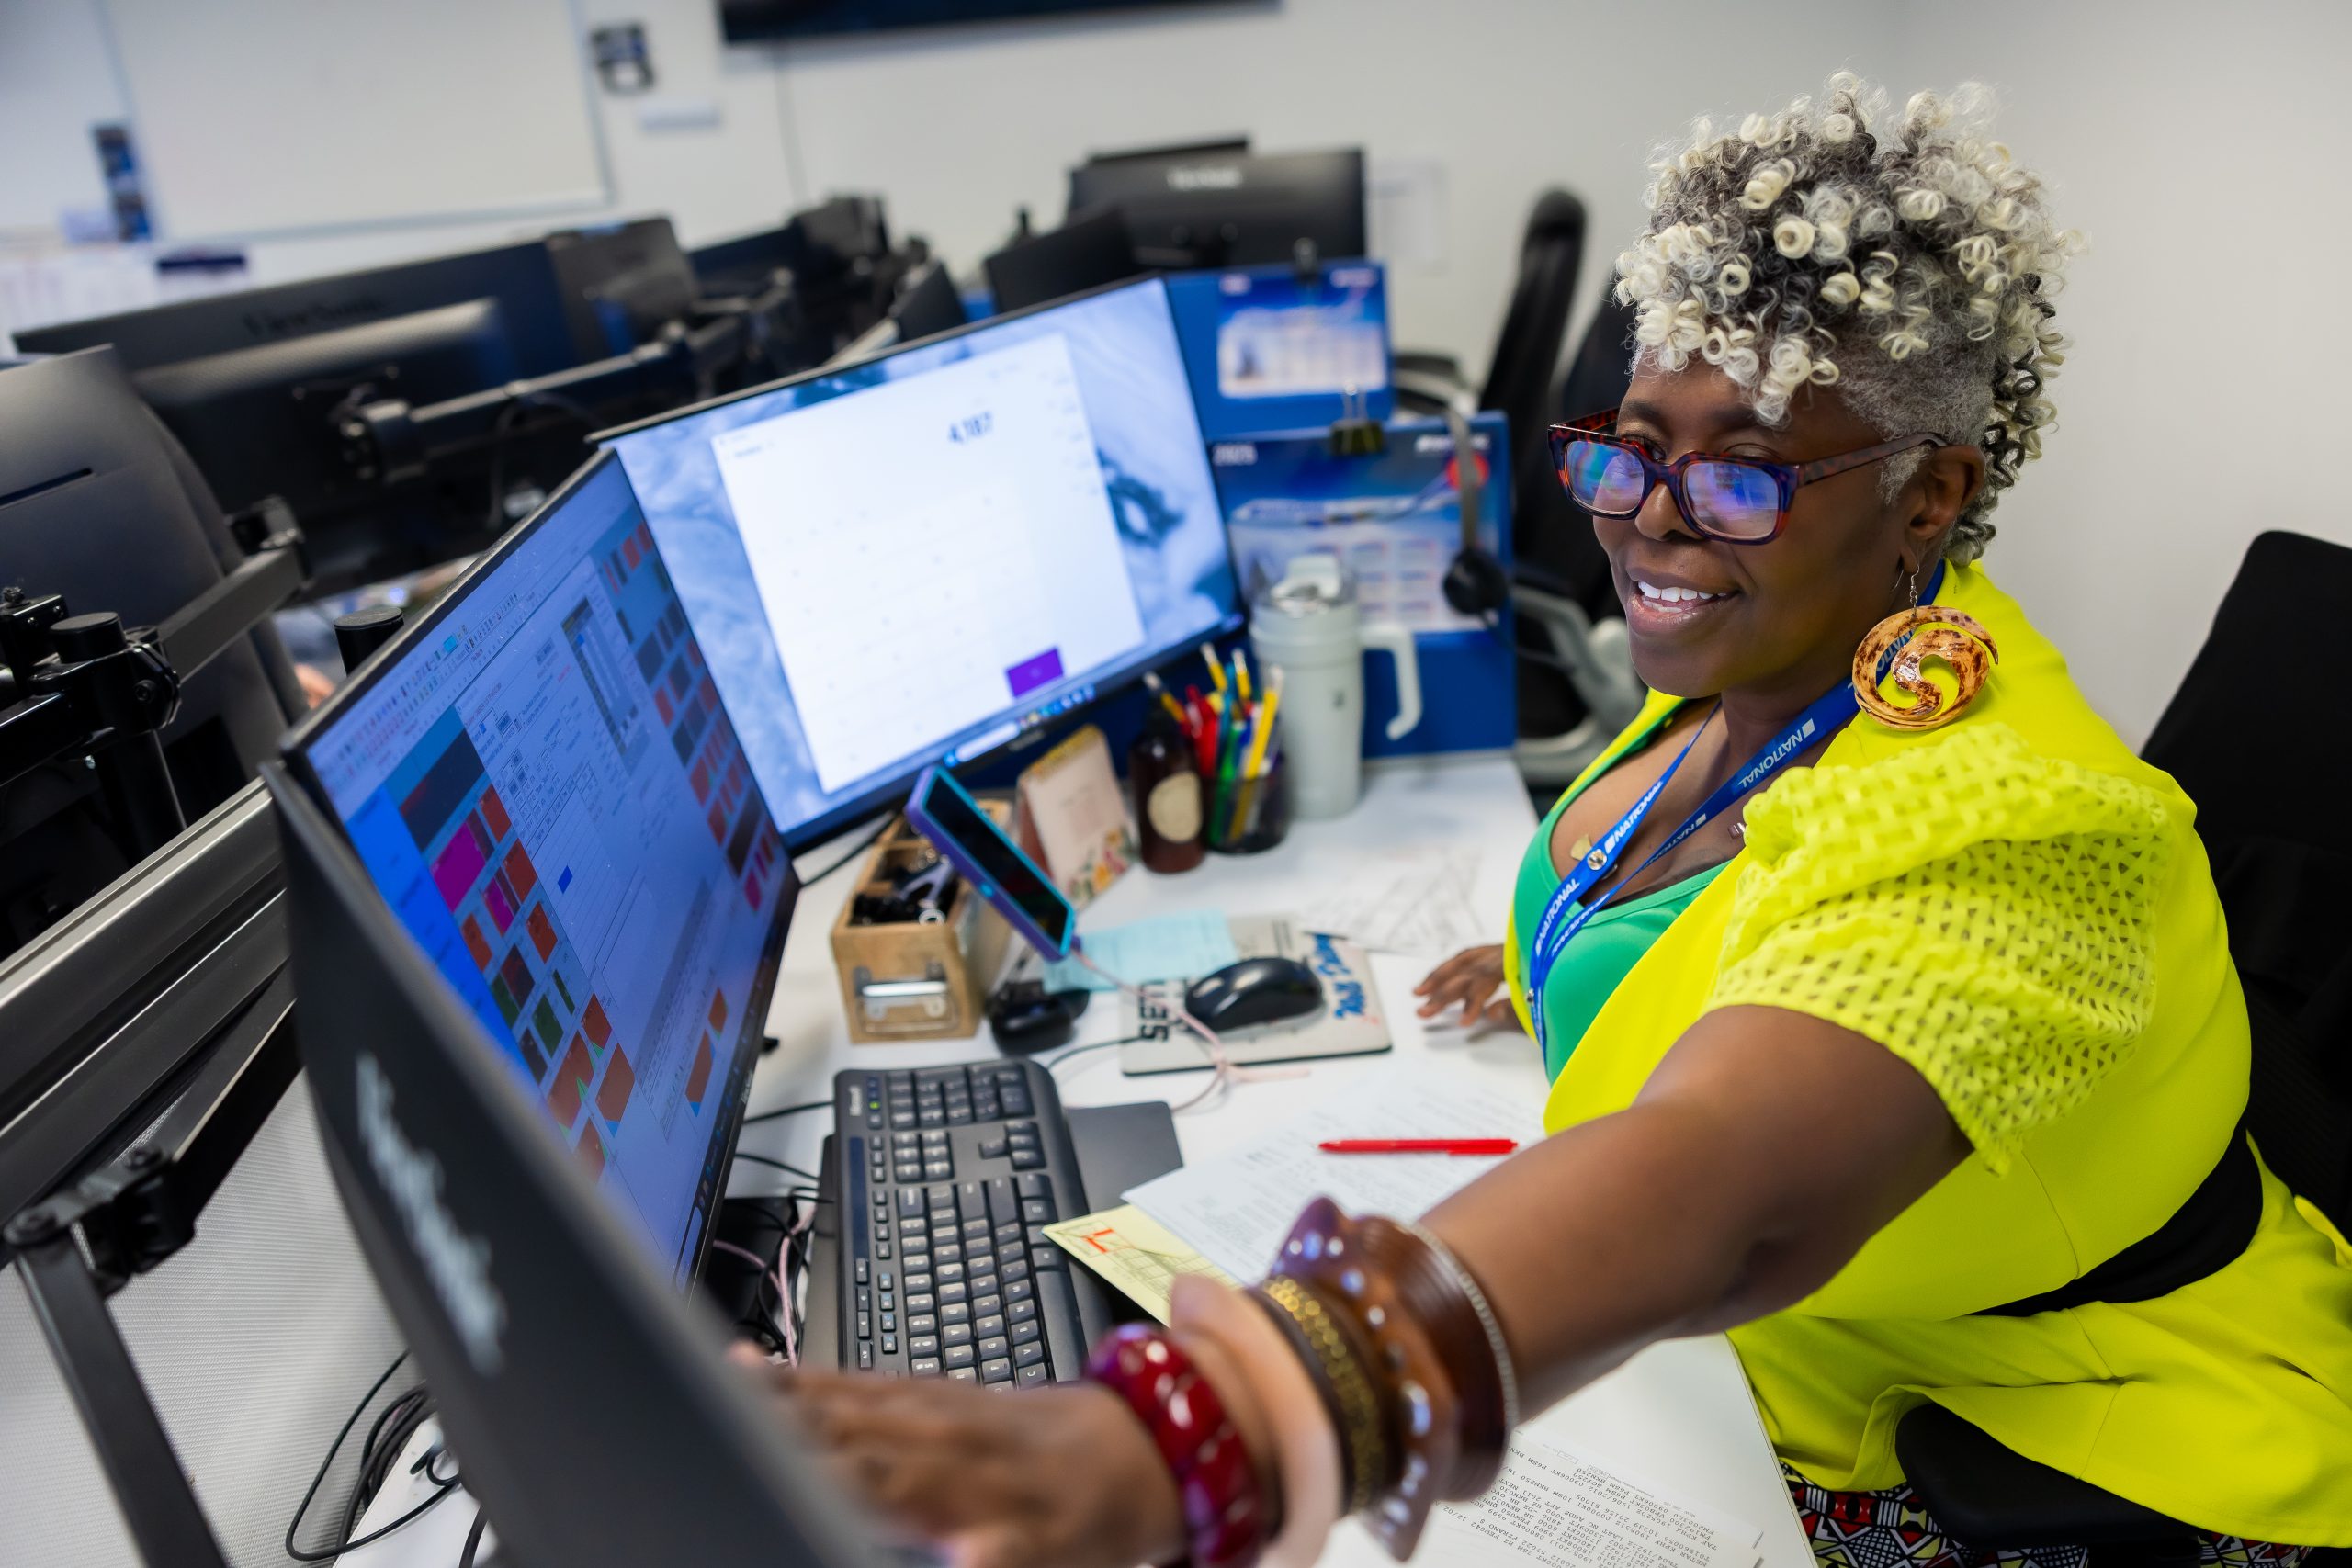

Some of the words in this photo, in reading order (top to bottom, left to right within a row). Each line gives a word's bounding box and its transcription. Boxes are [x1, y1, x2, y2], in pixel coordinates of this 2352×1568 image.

[1738, 729, 1804, 788] NATIONAL
[1614, 781, 1664, 842] NATIONAL
[1539, 877, 1580, 943] NATIONAL
[1528, 1457, 1547, 1470] P6SM
[1521, 1476, 1549, 1491] BKN250
[1551, 1470, 1584, 1486] 09006KT
[1573, 1472, 1602, 1488] SCT250
[1577, 1468, 1607, 1483] BKN250
[1499, 1479, 1519, 1490] NEXT
[1610, 1483, 1629, 1495] P6SM
[1500, 1486, 1528, 1502] BKN030
[1510, 1497, 1520, 1506] BR
[1523, 1490, 1541, 1501] 2011
[1553, 1490, 1572, 1503] 10SM
[1576, 1495, 1600, 1508] 51009
[1589, 1486, 1632, 1509] 1906/2012
[1606, 1488, 1626, 1499] P6SM
[1492, 1496, 1520, 1512] BKN030
[1545, 1501, 1561, 1510] AFT
[1577, 1502, 1611, 1521] 00000KT
[1630, 1499, 1664, 1518] VRB03KT
[1634, 1495, 1668, 1513] 09006KT
[1488, 1509, 1507, 1520] 9999
[1501, 1508, 1531, 1525] FEW050
[1543, 1513, 1561, 1526] 4800
[1546, 1509, 1566, 1520] 9000
[1565, 1511, 1585, 1522] AMDS
[1604, 1508, 1629, 1522] 20156
[1636, 1509, 1670, 1528] 190520Z
[1471, 1522, 1499, 1539] FEW042
[1510, 1520, 1544, 1540] 08006KT
[1534, 1526, 1554, 1537] 9999
[1538, 1519, 1557, 1531] 6000
[1569, 1520, 1604, 1540] 33009KT
[1615, 1521, 1649, 1540] 190551Z
[1634, 1522, 1659, 1537] 10239
[1669, 1516, 1711, 1540] FM192300
[1674, 1514, 1714, 1535] FM200300
[1562, 1531, 1596, 1551] 18006KT
[1566, 1527, 1600, 1545] 17006KT
[1601, 1529, 1623, 1541] LAST
[1676, 1528, 1697, 1540] KPHX
[1521, 1540, 1546, 1555] 57022
[1557, 1537, 1592, 1556] 15008KT
[1609, 1540, 1654, 1563] 2001/2002
[1655, 1540, 1676, 1552] KPHX
[1662, 1537, 1710, 1562] T01560056
[1701, 1541, 1717, 1551] TAF
[1680, 1551, 1707, 1567] METAR
